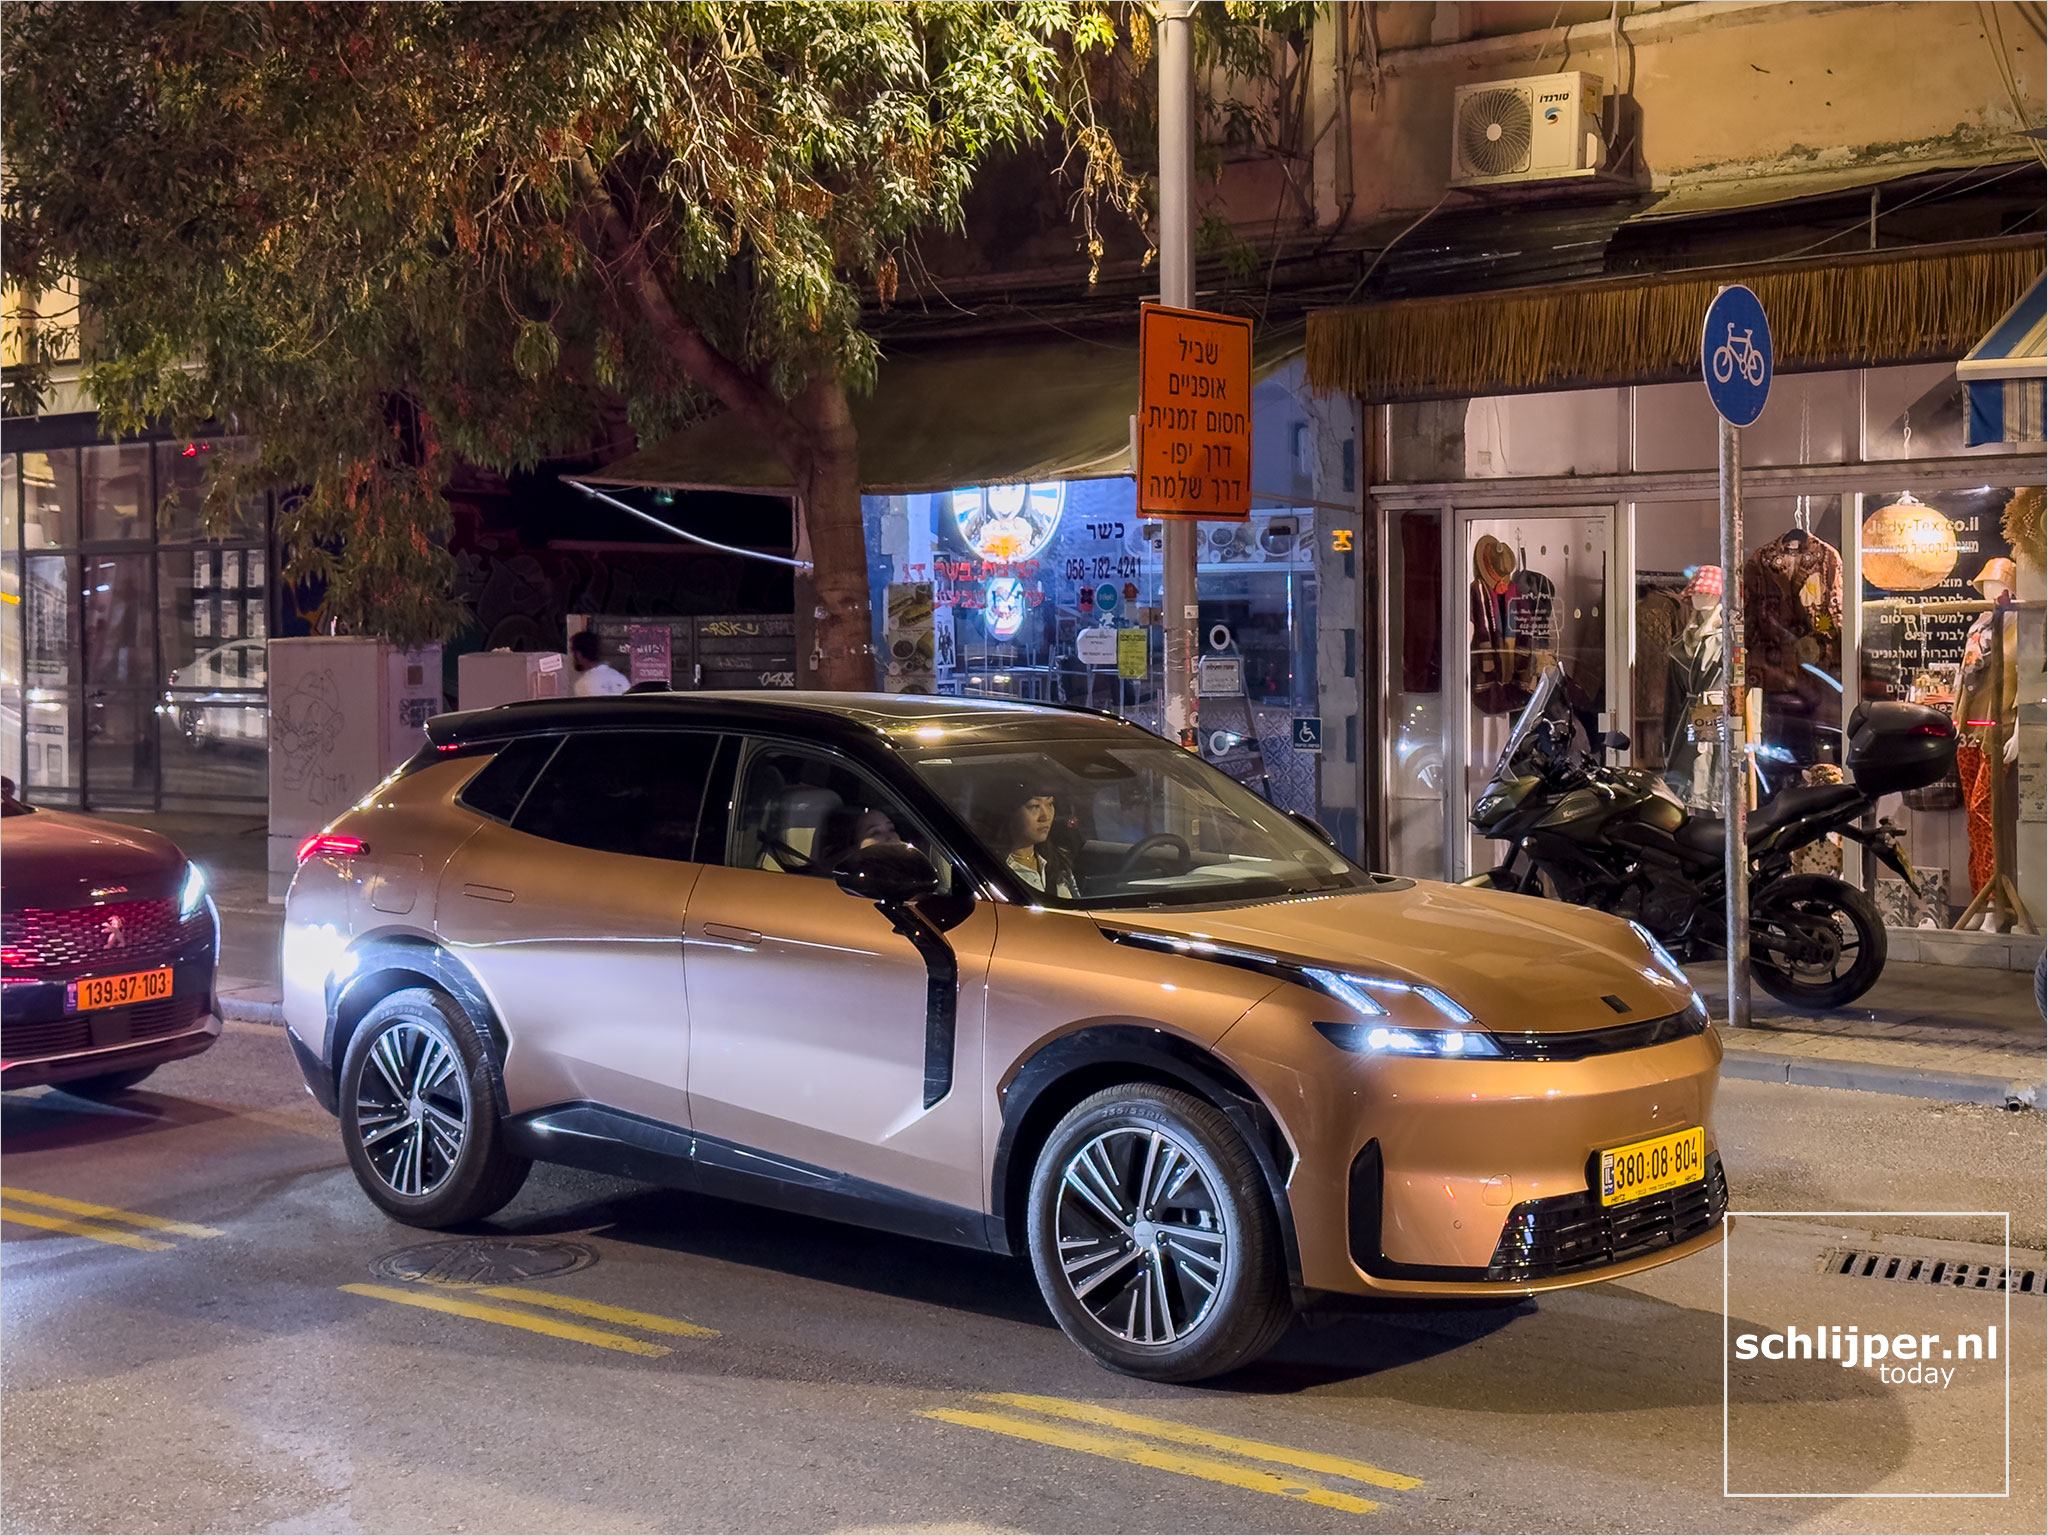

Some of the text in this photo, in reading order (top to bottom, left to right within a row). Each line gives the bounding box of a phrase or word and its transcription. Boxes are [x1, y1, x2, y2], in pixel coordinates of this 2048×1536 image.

[1539, 92, 1569, 103] טורנדו
[1178, 333, 1218, 365] שביל
[1169, 373, 1226, 400] אופניים
[1148, 405, 1245, 435] חסום זמנית
[1202, 444, 1232, 473] דרך
[1150, 470, 1241, 505] דרך שלמה
[1086, 522, 1125, 540] כשר
[1867, 517, 1979, 535] Judy-Tex.co.il
[1066, 556, 1142, 580] 058-782-4241
[1936, 628, 1965, 641] לבתי
